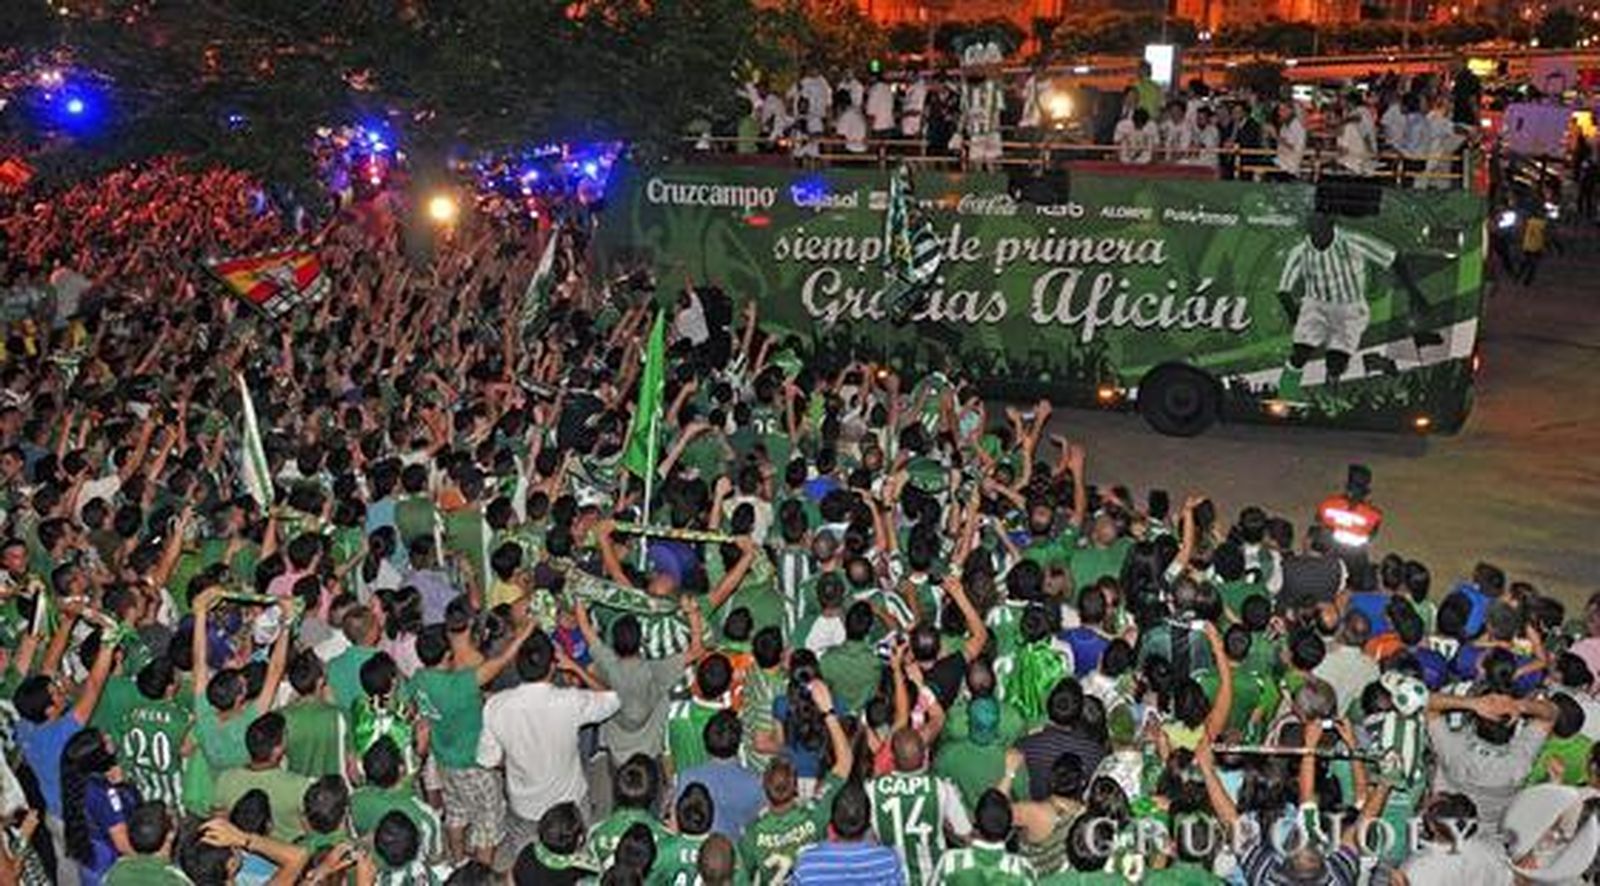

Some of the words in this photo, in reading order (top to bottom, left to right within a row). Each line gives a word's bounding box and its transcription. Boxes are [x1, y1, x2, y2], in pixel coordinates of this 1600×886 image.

[646, 178, 777, 214] Cruzcampo
[938, 222, 981, 262] de
[994, 228, 1168, 268] primera
[1030, 267, 1253, 343] Afición
[124, 728, 170, 772] 20
[878, 775, 930, 795] CAPI
[881, 796, 933, 846] 14
